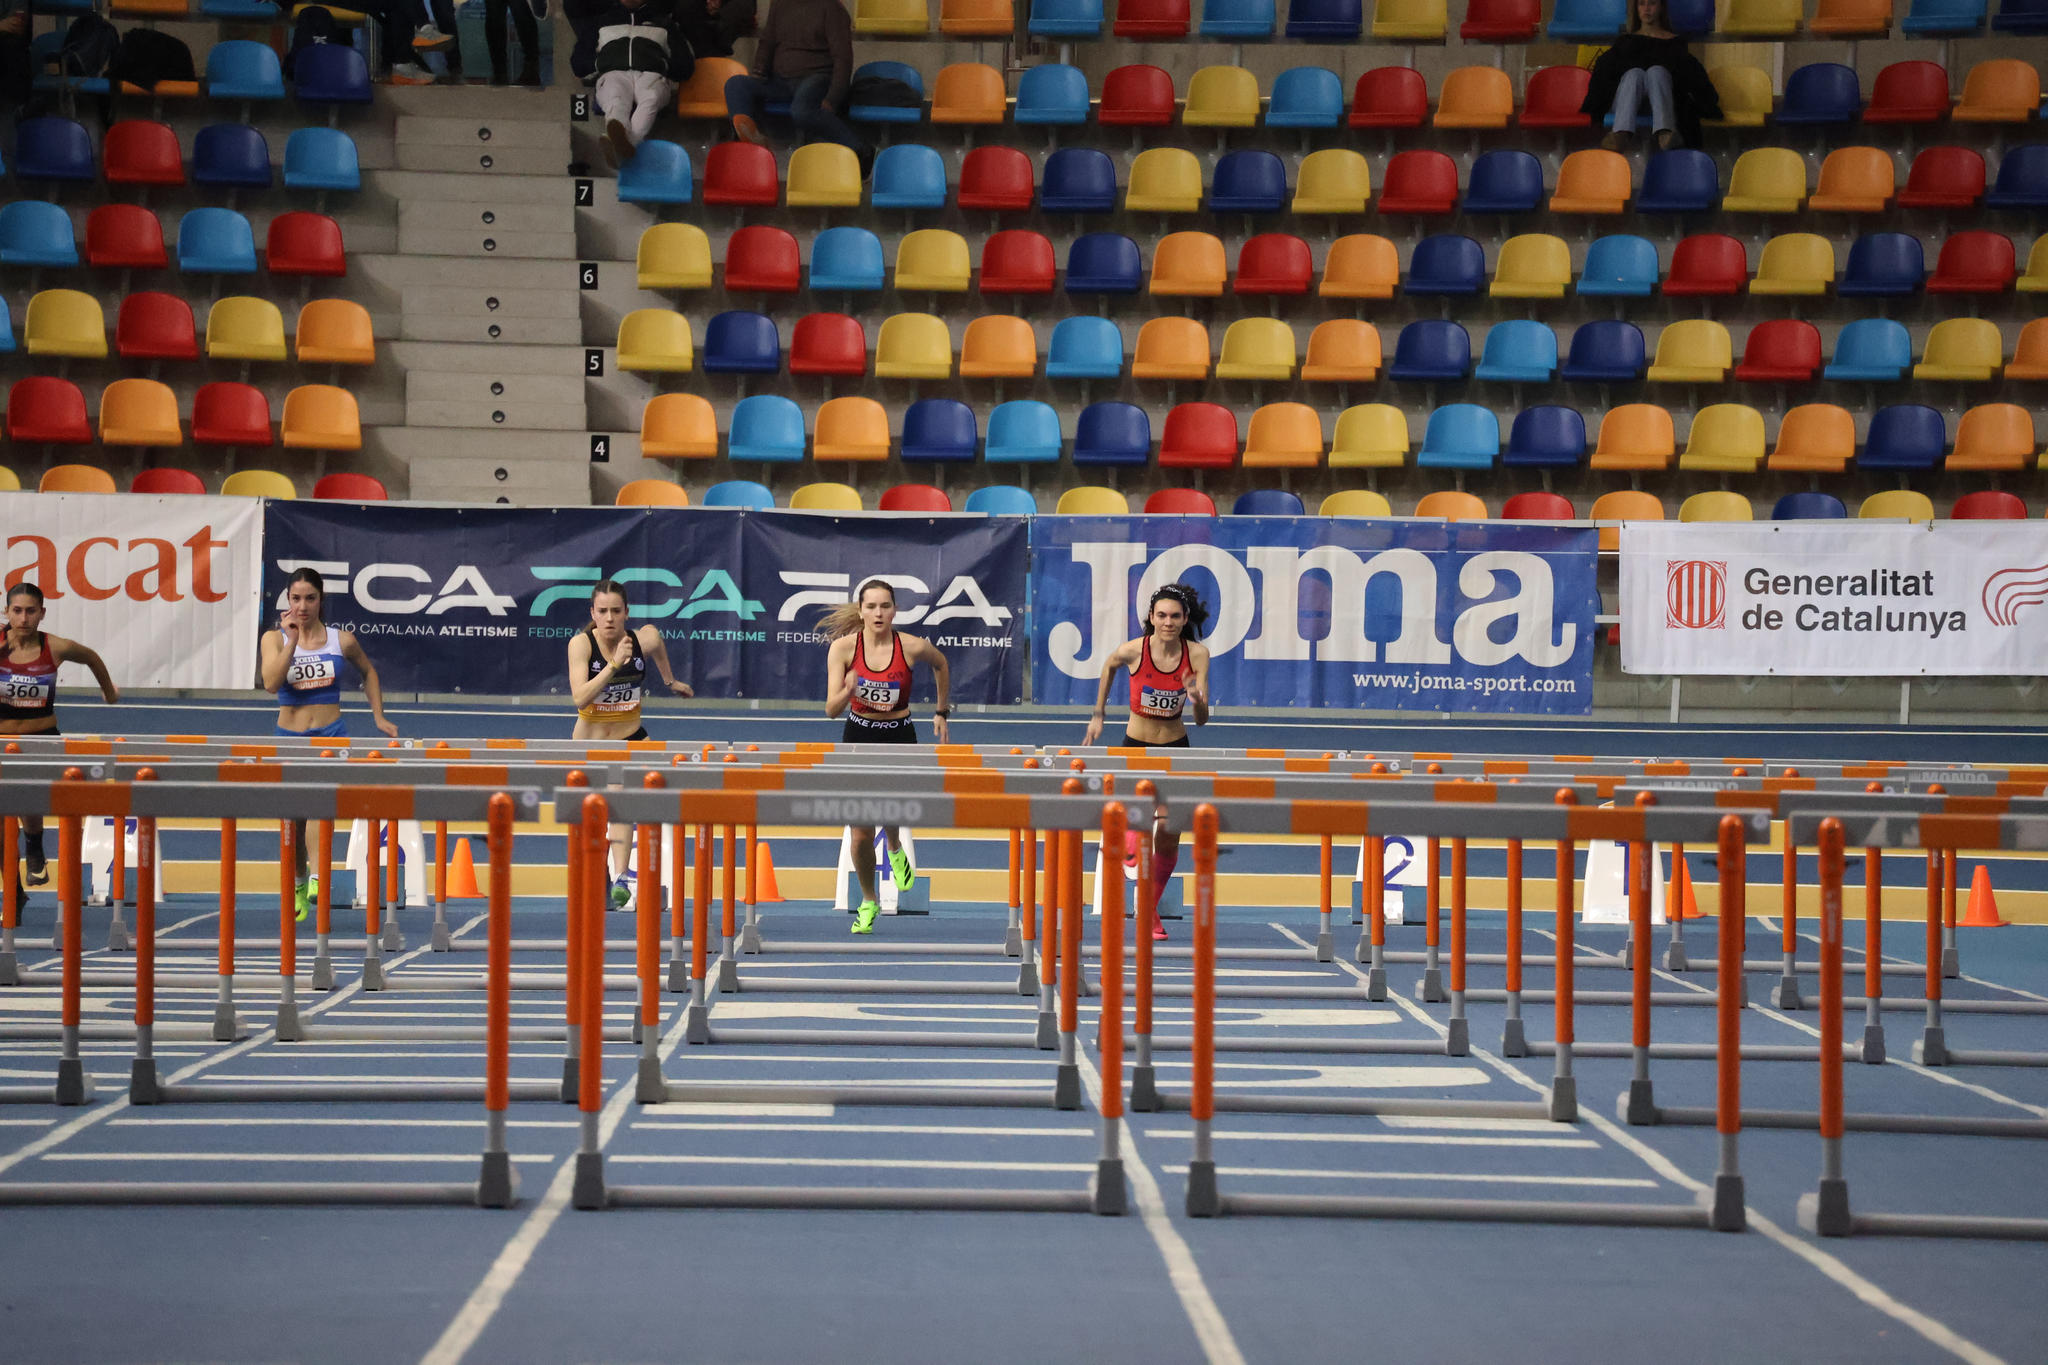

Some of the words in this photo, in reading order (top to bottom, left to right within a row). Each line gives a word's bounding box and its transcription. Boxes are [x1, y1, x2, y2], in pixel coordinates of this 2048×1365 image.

[574, 100, 585, 116] 8
[579, 185, 589, 201] 7
[583, 269, 594, 284] 6
[589, 355, 600, 370] 5
[594, 441, 606, 456] 4
[1743, 567, 1934, 597] Generalitat
[529, 566, 767, 621] FCA
[777, 571, 1013, 627] FCA
[1048, 542, 1577, 680] Joma
[1742, 603, 1784, 631] de
[1795, 603, 1967, 639] Catalunya
[360, 623, 435, 636] CATALANA
[439, 626, 517, 638] ATLETISME
[528, 627, 581, 638] FEDERA
[690, 630, 766, 642] ATLETISME
[936, 635, 1013, 648] ATLETISME
[294, 663, 326, 680] 303
[6, 684, 39, 698] 360
[1353, 671, 1577, 697] www.joma-sport.com
[602, 690, 633, 704] 230
[860, 688, 891, 703] 263
[1149, 697, 1179, 710] 308
[848, 711, 870, 728] NIKE
[870, 721, 899, 730] PRO
[813, 799, 923, 820] MONDO
[1383, 835, 1415, 892] 2
